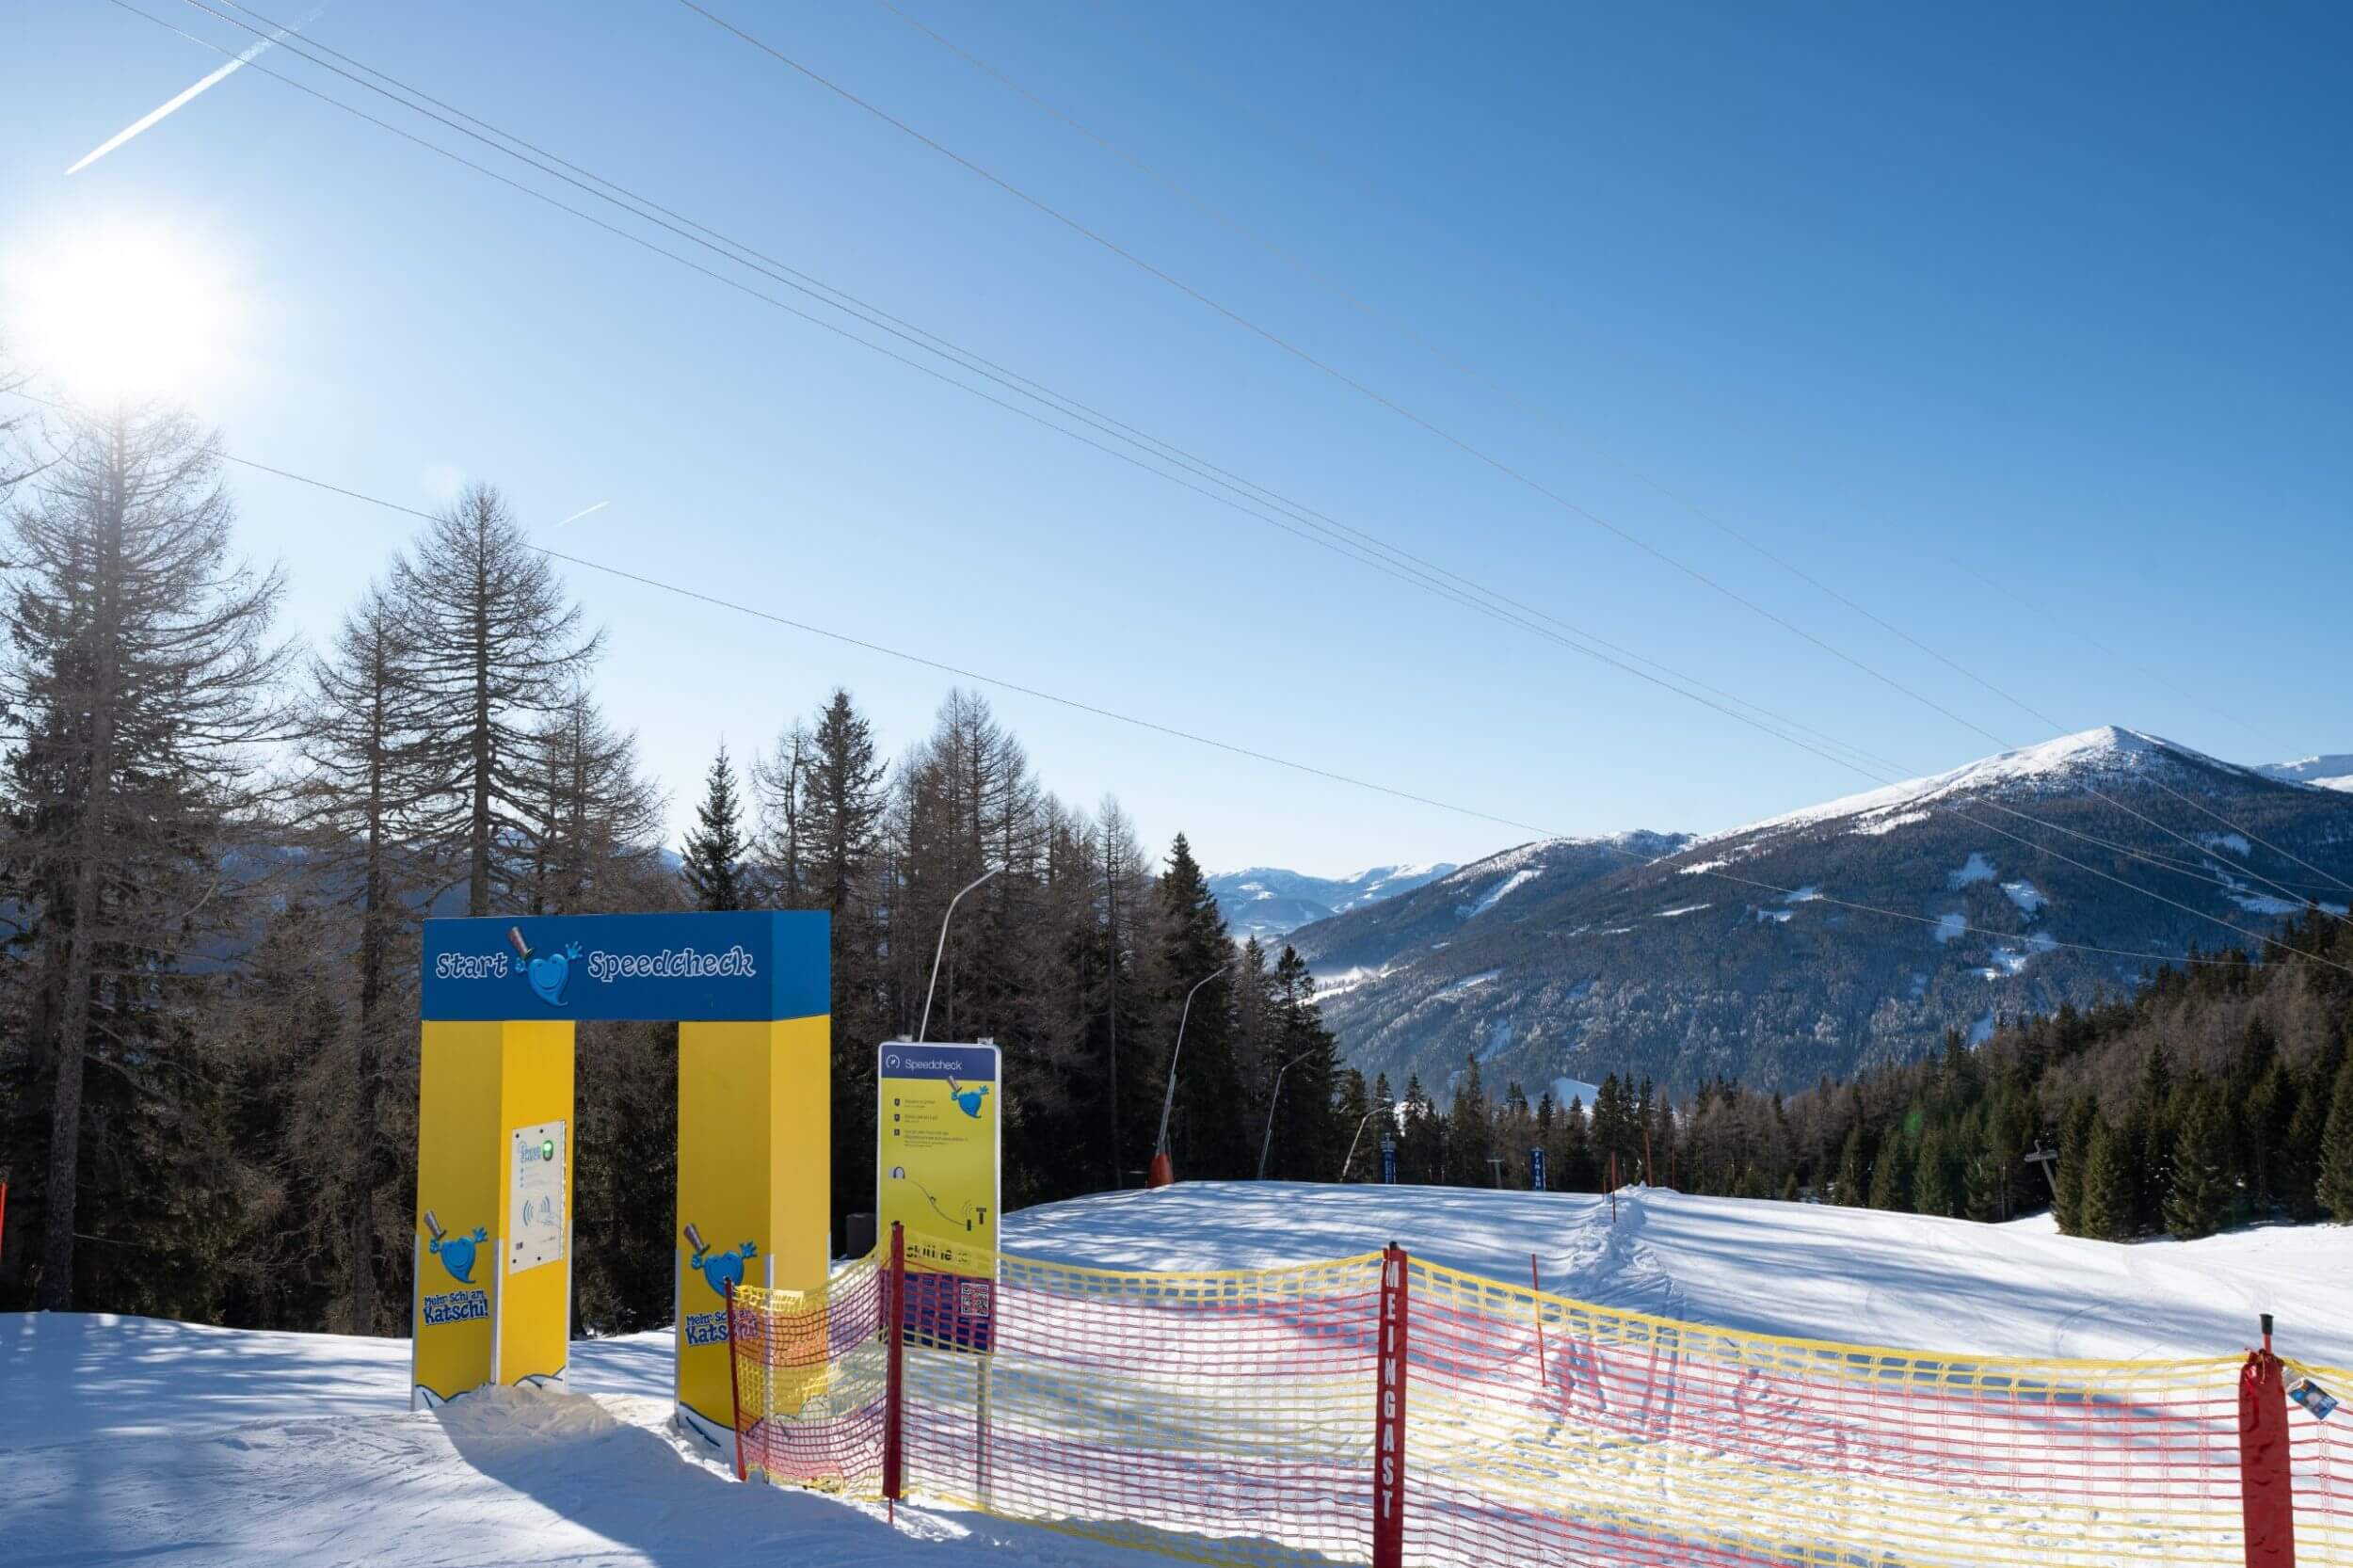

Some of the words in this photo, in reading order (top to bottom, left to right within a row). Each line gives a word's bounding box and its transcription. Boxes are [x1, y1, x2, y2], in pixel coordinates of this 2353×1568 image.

[436, 951, 508, 979] Start
[587, 945, 756, 983] Speedcheck
[904, 1059, 963, 1071] Speedcheck
[423, 1298, 488, 1324] Katschi!
[424, 1294, 447, 1306] Mehr
[686, 1313, 712, 1326] Mehr
[685, 1320, 758, 1345] Katshi!
[1382, 1260, 1400, 1519] MEINGAST
